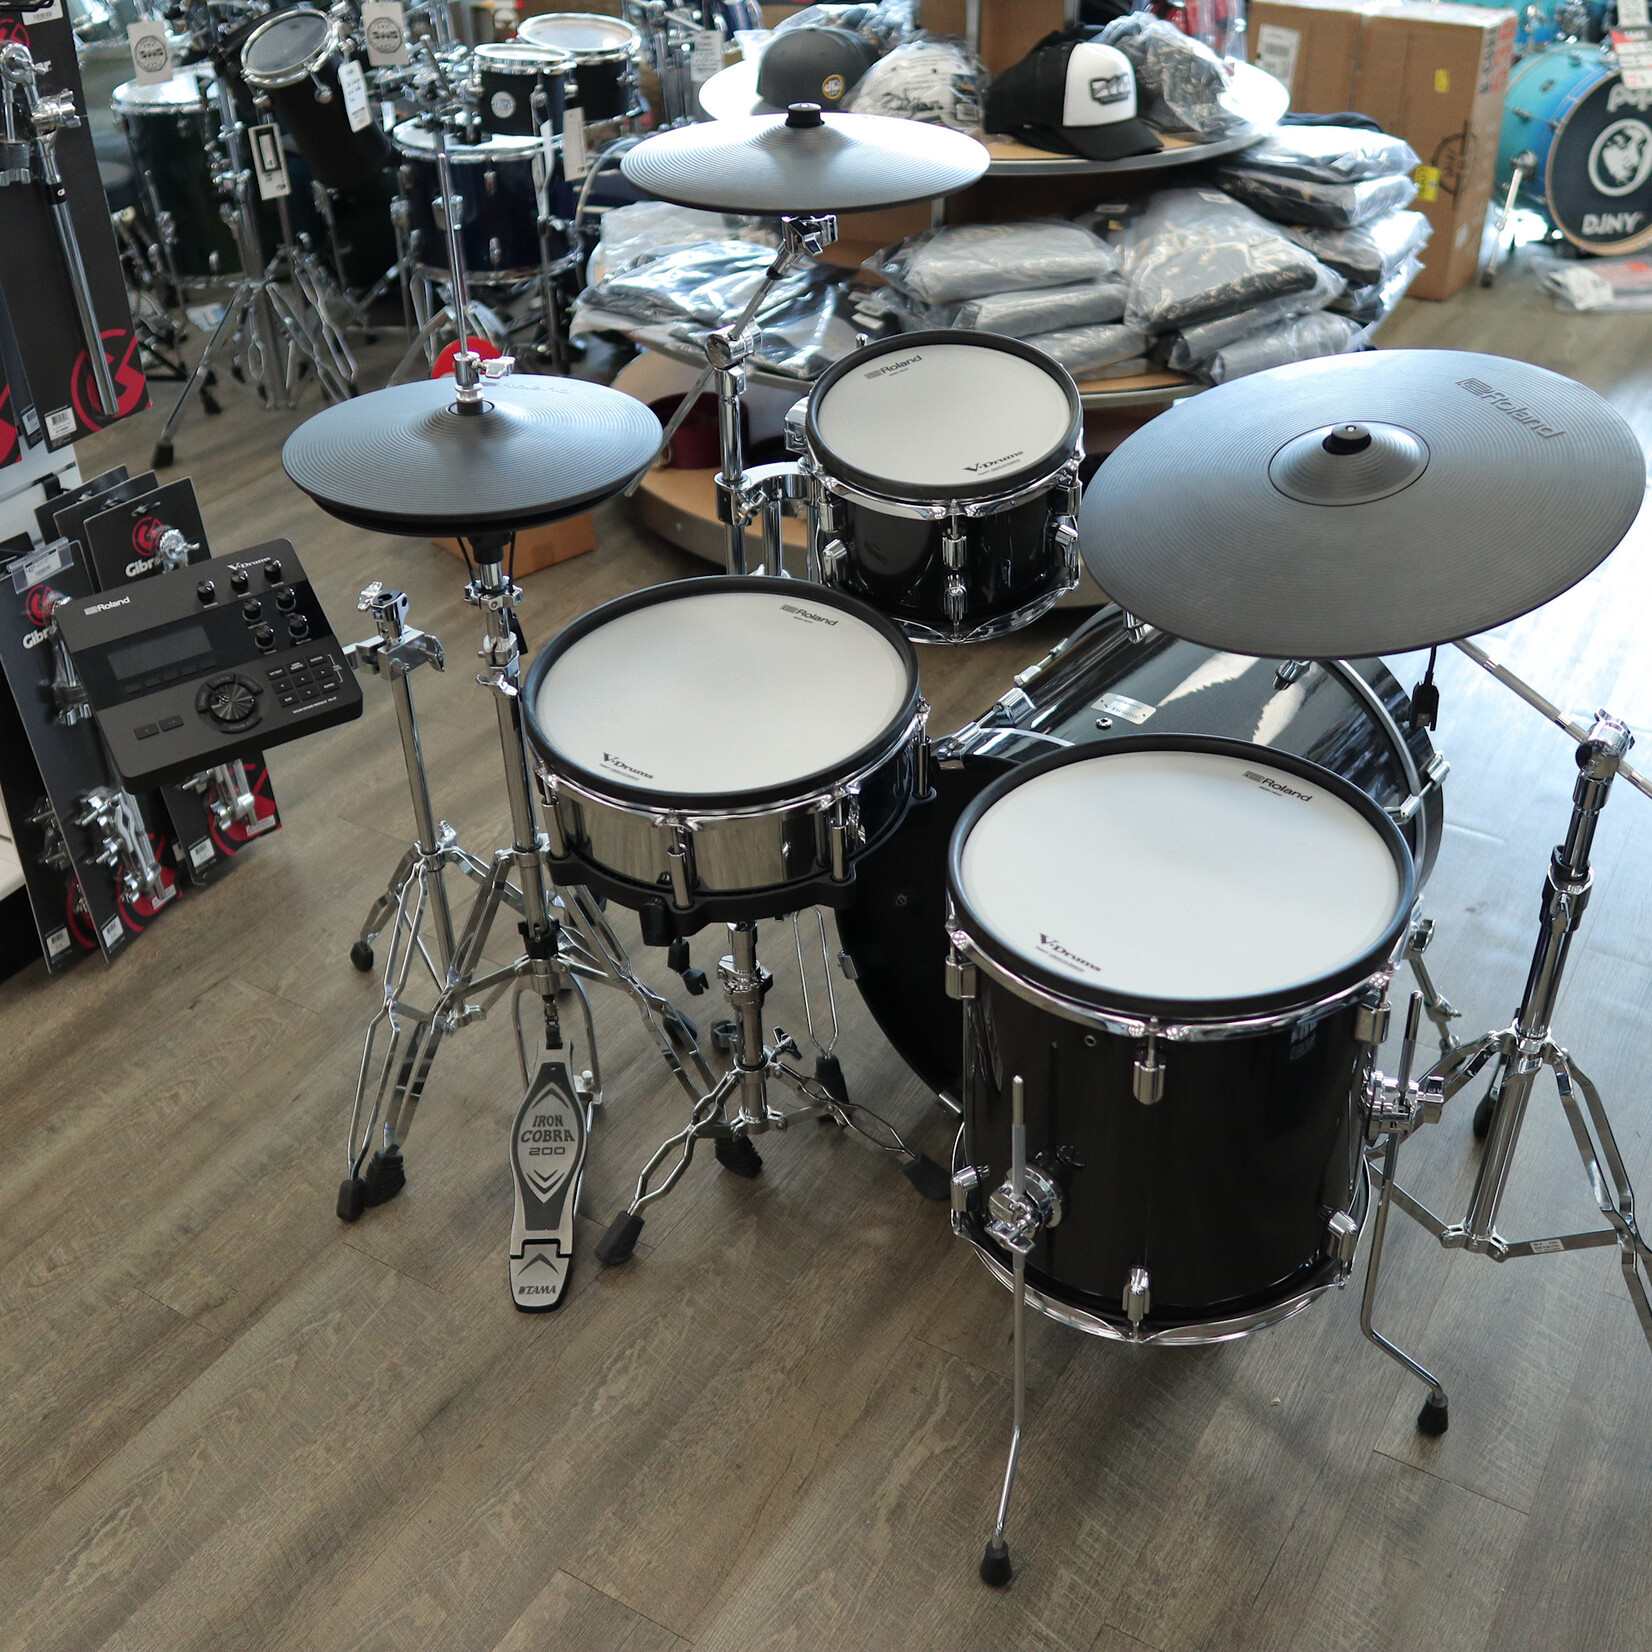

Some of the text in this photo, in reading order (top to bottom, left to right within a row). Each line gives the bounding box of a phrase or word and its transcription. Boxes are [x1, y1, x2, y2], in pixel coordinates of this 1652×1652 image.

[1581, 212, 1643, 235] DJNY
[880, 355, 923, 374] Roland
[1481, 390, 1566, 440] Roland
[963, 451, 1024, 472] V-Drums
[227, 557, 271, 571] V-Drums
[97, 596, 131, 612] Roland
[795, 608, 839, 626] Roland
[603, 752, 654, 779] V-Drums
[1262, 778, 1313, 802] Roland
[1039, 932, 1102, 972] V-Drums
[532, 1114, 564, 1128] IRON
[520, 1129, 575, 1143] COBRA
[528, 1147, 566, 1156] 200
[524, 1285, 556, 1295] TAMA
